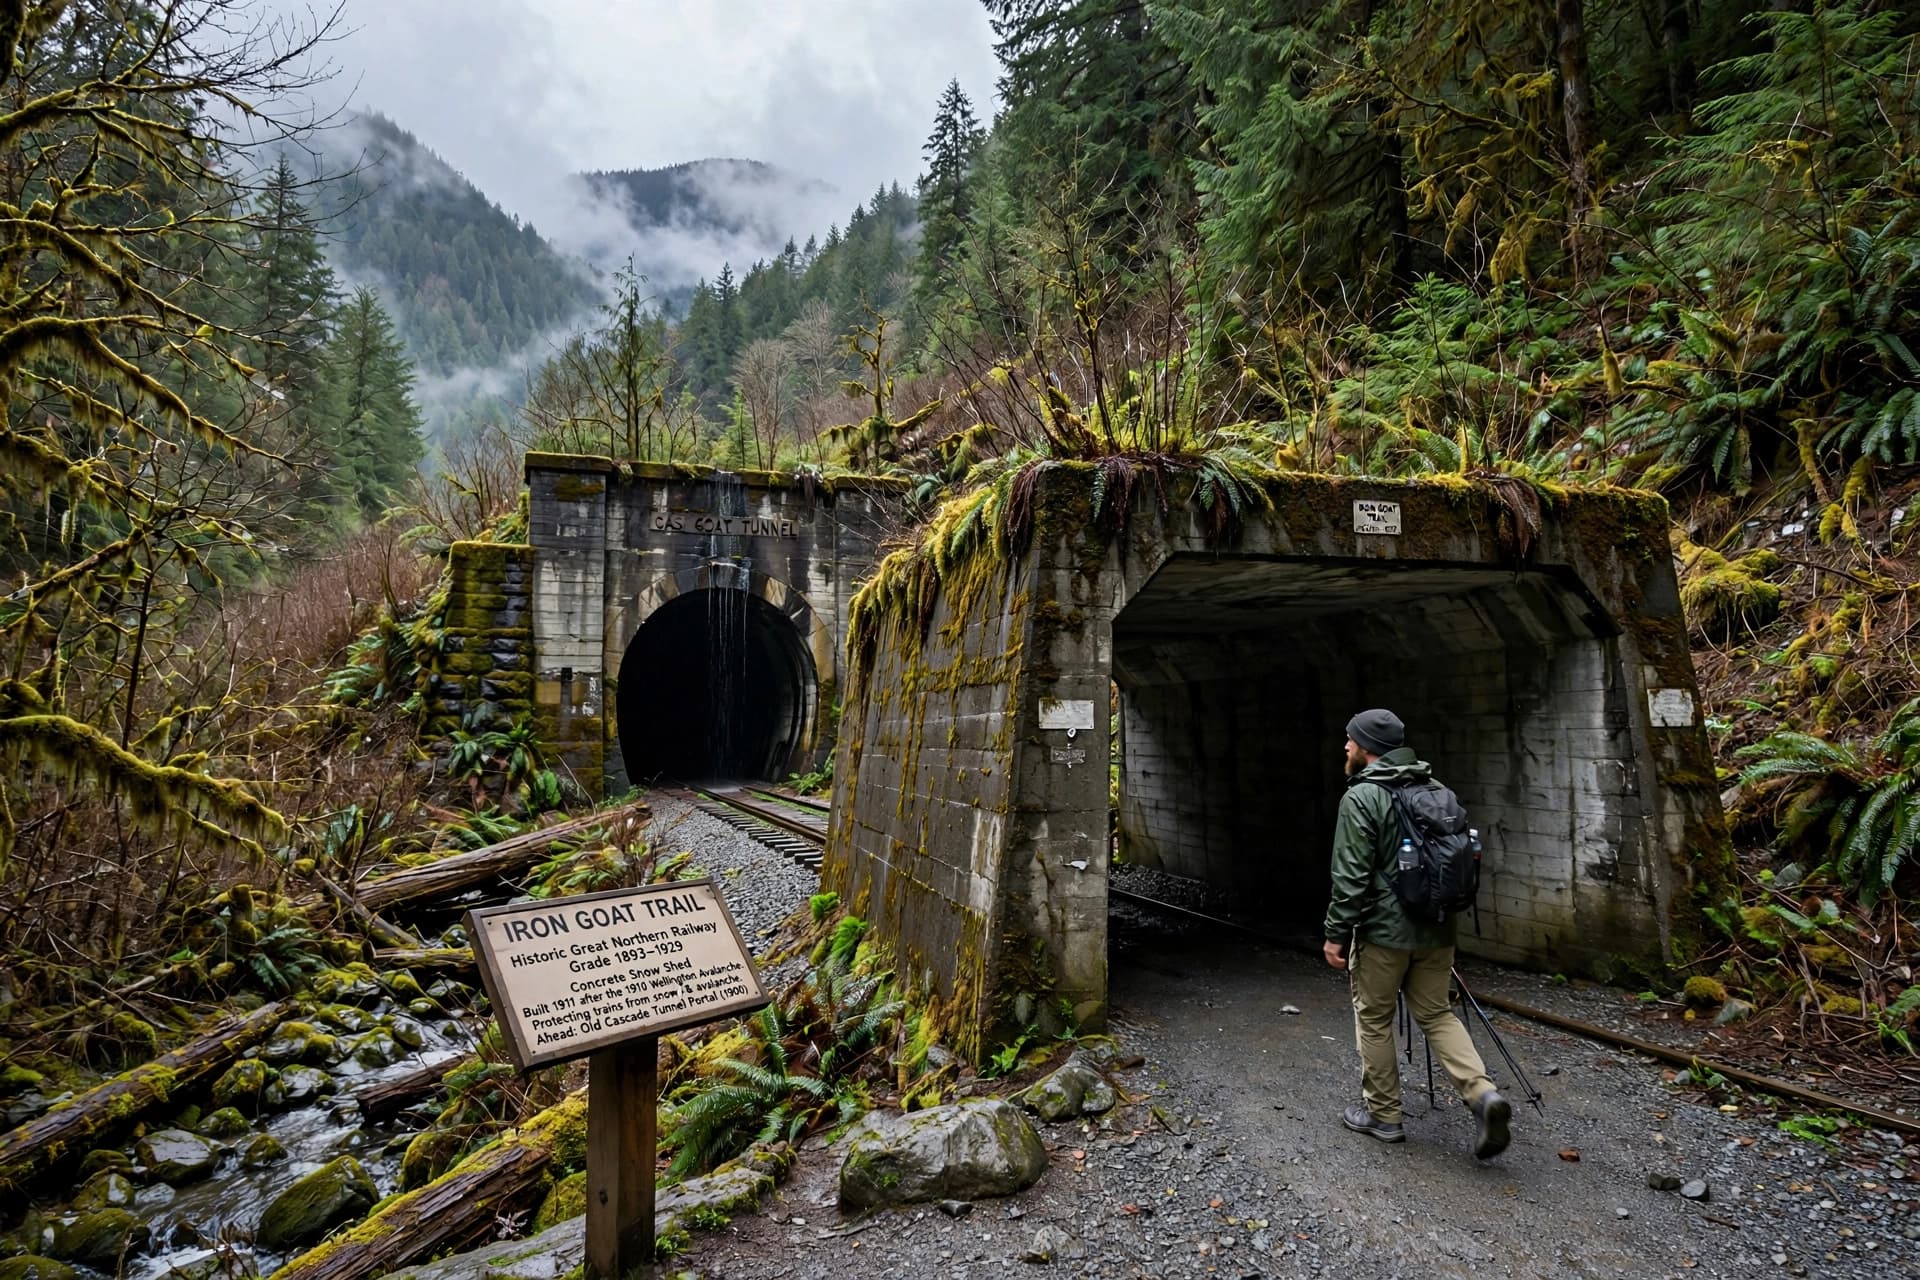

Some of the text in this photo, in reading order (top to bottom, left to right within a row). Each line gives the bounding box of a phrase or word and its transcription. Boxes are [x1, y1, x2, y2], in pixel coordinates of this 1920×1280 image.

[742, 520, 798, 537] TUNNEL
[503, 894, 706, 942] IRON GOAT TRAIL
[510, 922, 716, 968] Historic Great Northern Railway
[570, 940, 683, 972] Grade 1893–1929
[522, 1004, 550, 1018] Built
[552, 997, 576, 1011] 1911
[580, 993, 602, 1005] after
[606, 988, 623, 998] the
[625, 981, 648, 994] 1910
[650, 972, 697, 986] Wellington
[570, 958, 692, 992] Concrete Snow Shed
[532, 1010, 591, 1030] Protecting
[593, 1002, 624, 1016] trains
[626, 996, 650, 1008] from
[537, 984, 749, 1046] Ahead: Old Cascade Tunnel Portal (1900)
